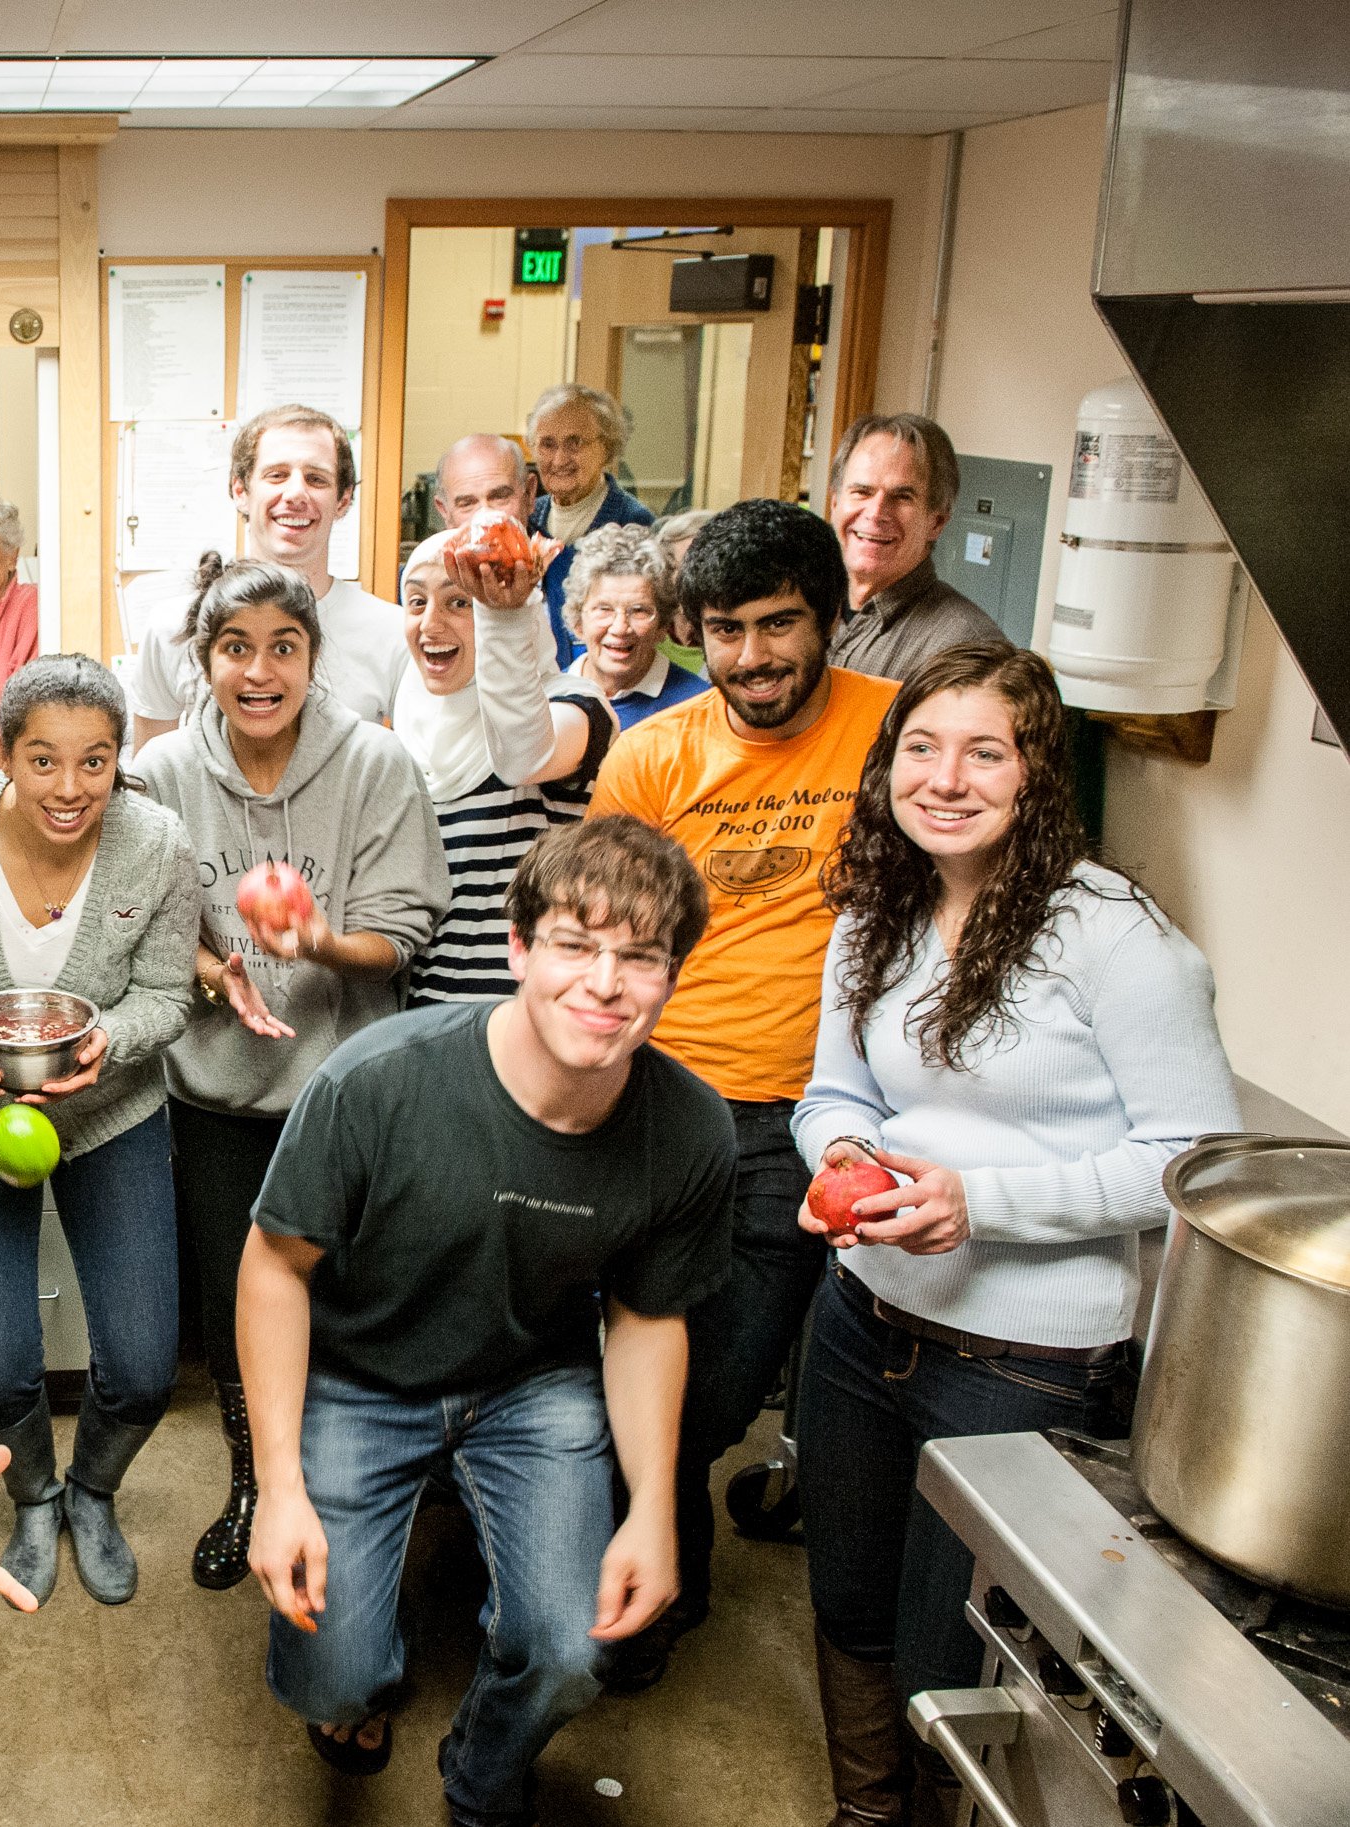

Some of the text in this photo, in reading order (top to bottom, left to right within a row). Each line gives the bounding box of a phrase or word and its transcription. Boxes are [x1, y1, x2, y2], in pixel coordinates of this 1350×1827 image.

[522, 251, 562, 282] EXIT
[688, 798, 750, 817] apture
[756, 795, 786, 812] the
[211, 904, 234, 915] EST.
